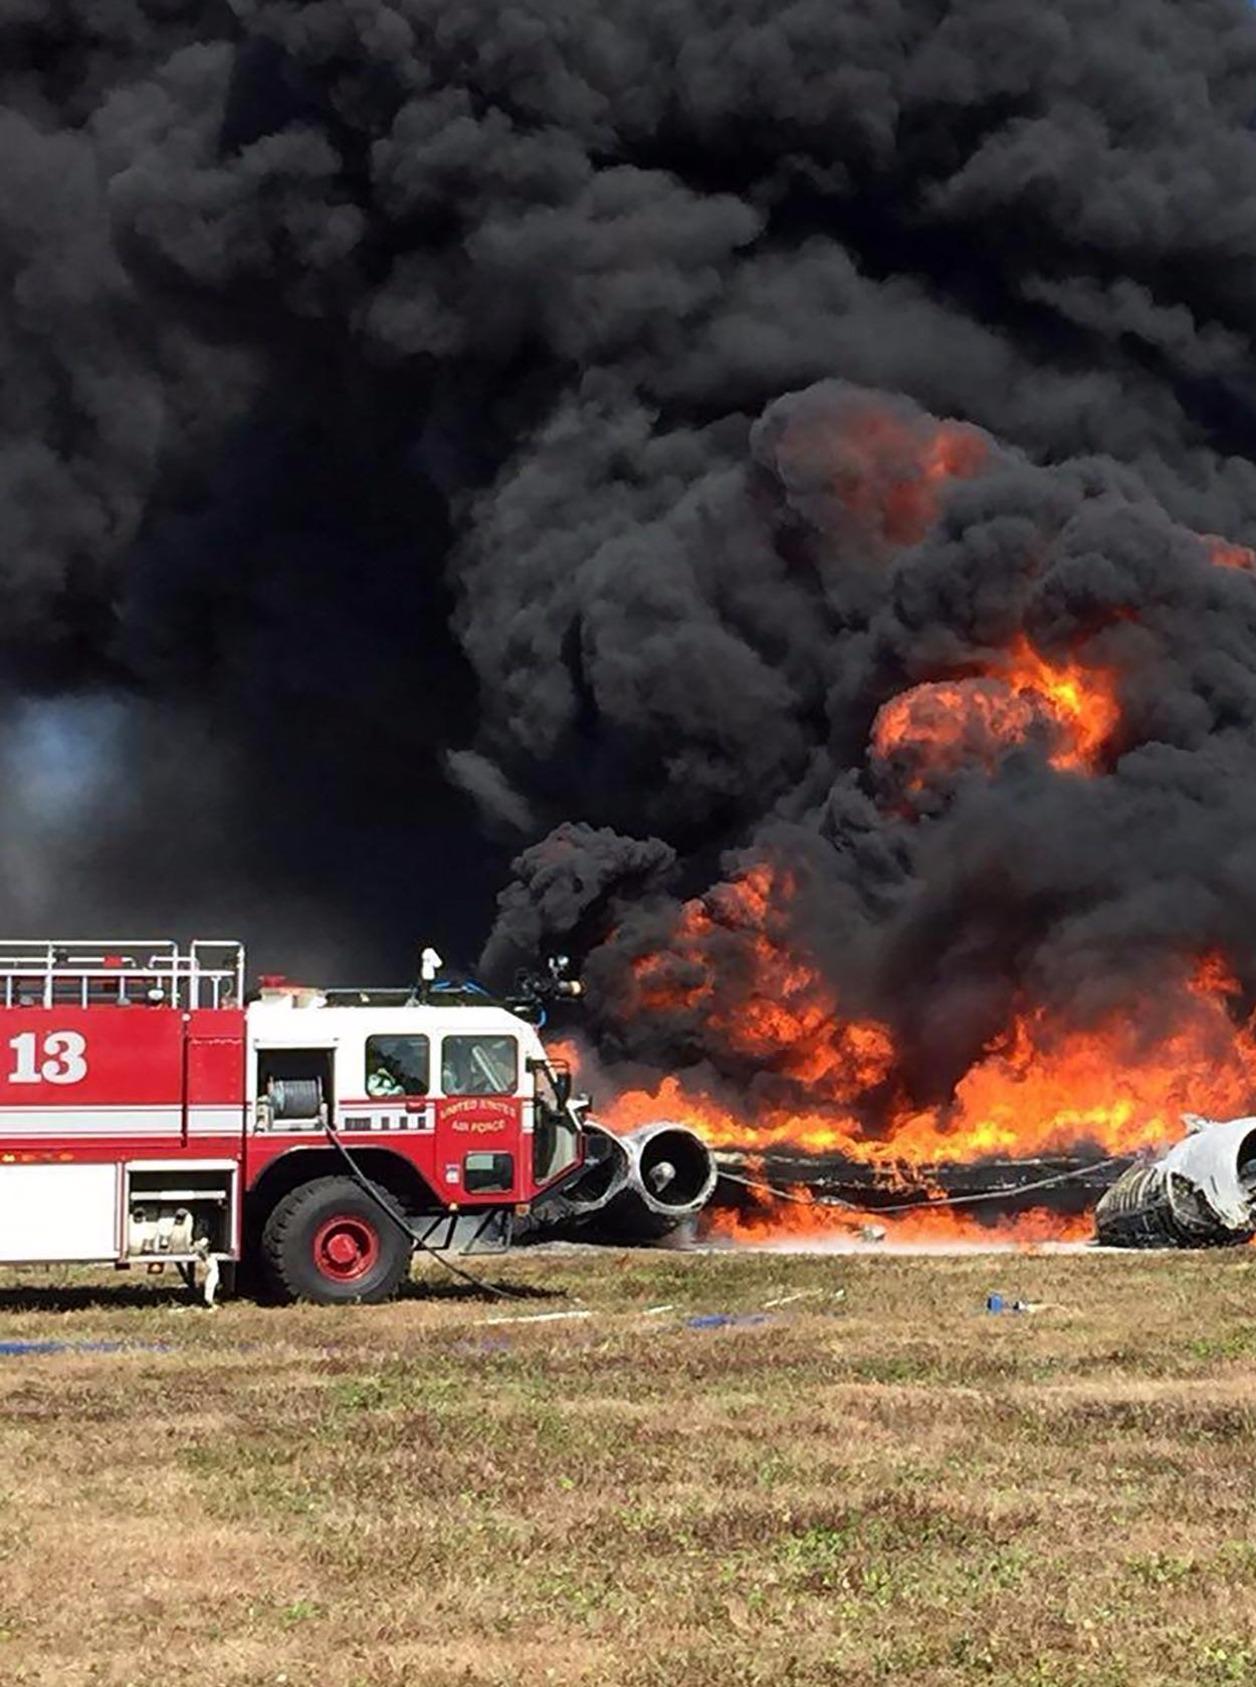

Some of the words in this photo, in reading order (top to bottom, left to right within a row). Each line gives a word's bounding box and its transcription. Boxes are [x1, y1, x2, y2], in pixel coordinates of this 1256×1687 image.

[8, 1030, 88, 1085] 13
[440, 1099, 478, 1119] UNITED
[471, 1119, 506, 1134] FORCE
